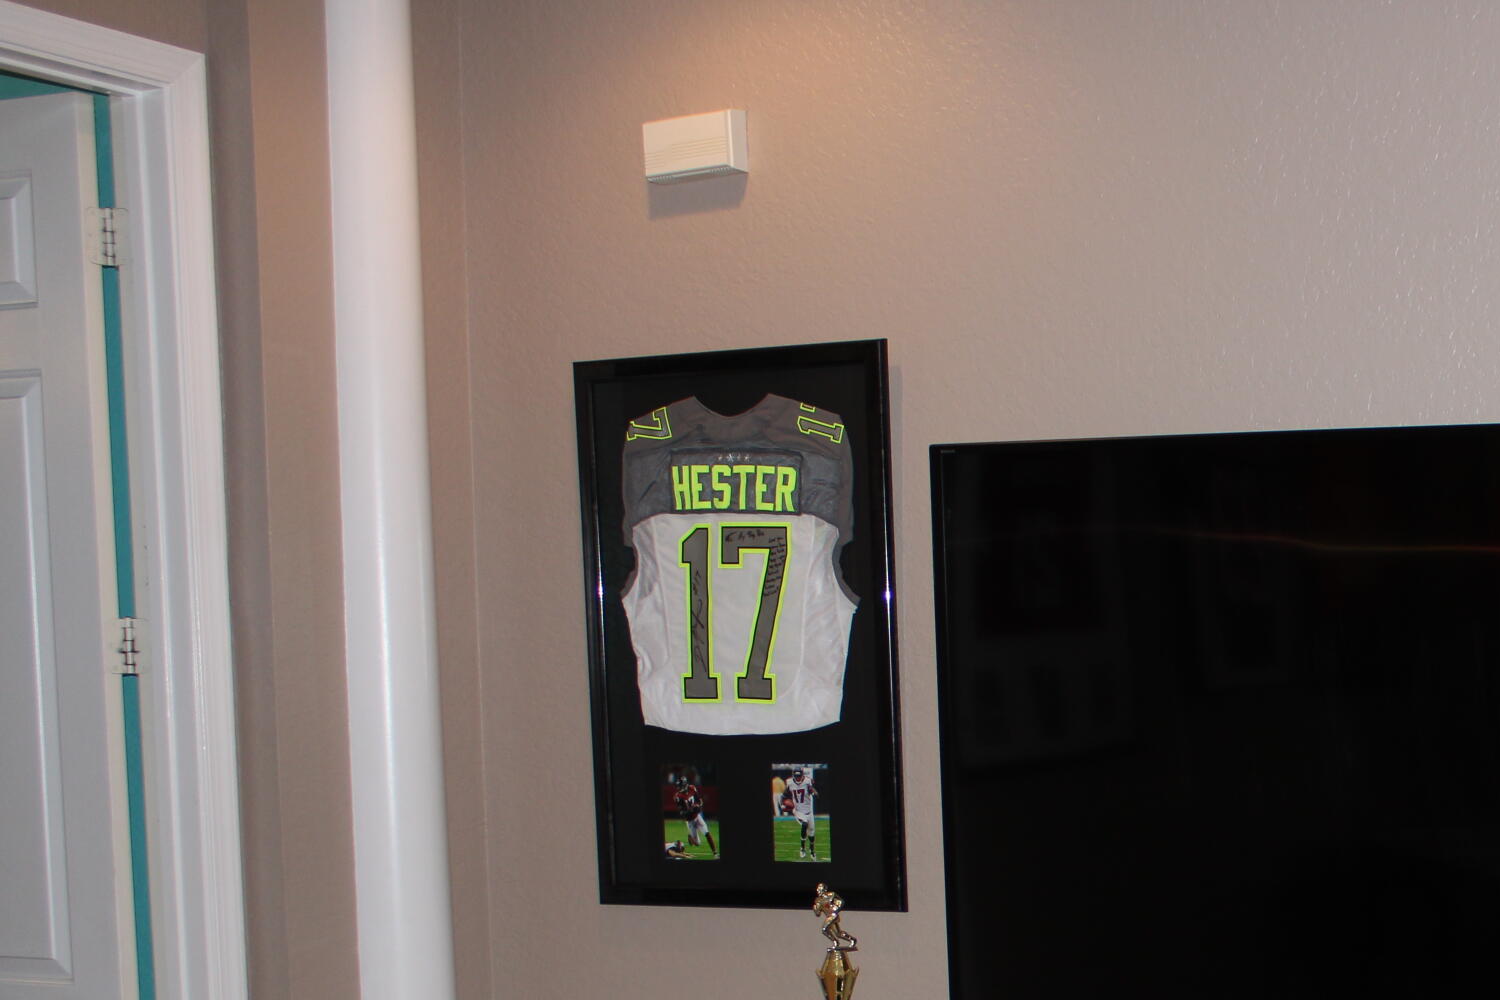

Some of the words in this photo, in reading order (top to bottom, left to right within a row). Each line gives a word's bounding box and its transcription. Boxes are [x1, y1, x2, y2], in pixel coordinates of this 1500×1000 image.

[671, 464, 798, 513] HESTER
[678, 521, 792, 705] 17
[793, 788, 806, 804] 17
